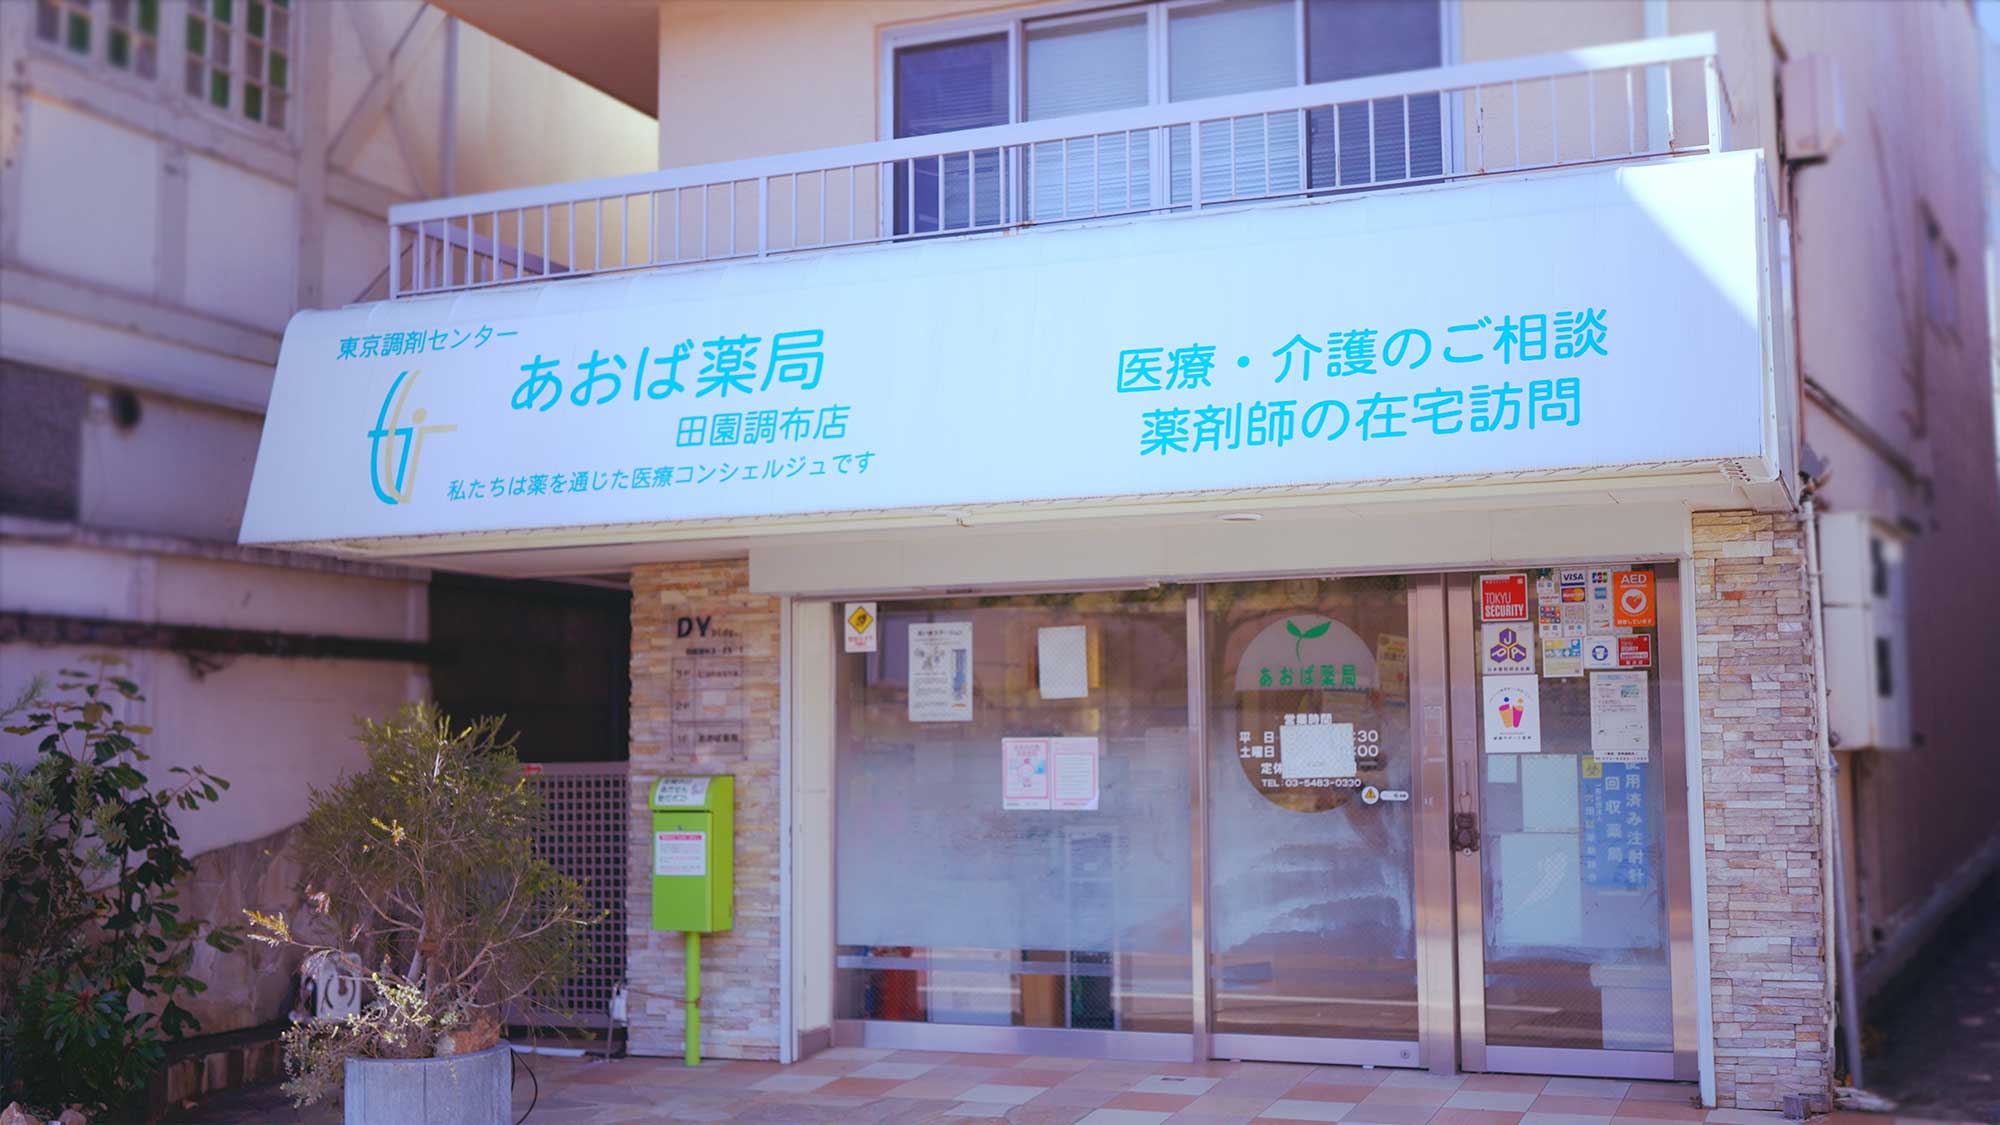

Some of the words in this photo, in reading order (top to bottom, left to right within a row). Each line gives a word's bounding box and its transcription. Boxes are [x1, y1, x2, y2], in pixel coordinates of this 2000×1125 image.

[337, 325, 518, 360] 東京調剤センター
[1117, 308, 1608, 393] 医療・介護のご相談
[511, 329, 824, 412] あおば薬局
[676, 404, 851, 447] 田園調布店
[1140, 377, 1580, 456] 薬剤師の在宅訪問
[448, 451, 875, 500] 私たちは薬を通じた医療コンシェルジュです
[1563, 573, 1584, 582] VISA
[1592, 572, 1608, 583] JCB
[1621, 574, 1647, 585] AED
[1485, 592, 1511, 604] TOKYU
[1485, 604, 1524, 617] SECURITY
[677, 615, 711, 638] DY
[1259, 664, 1357, 687] あおば薬局
[1240, 746, 1275, 758] 土曜日
